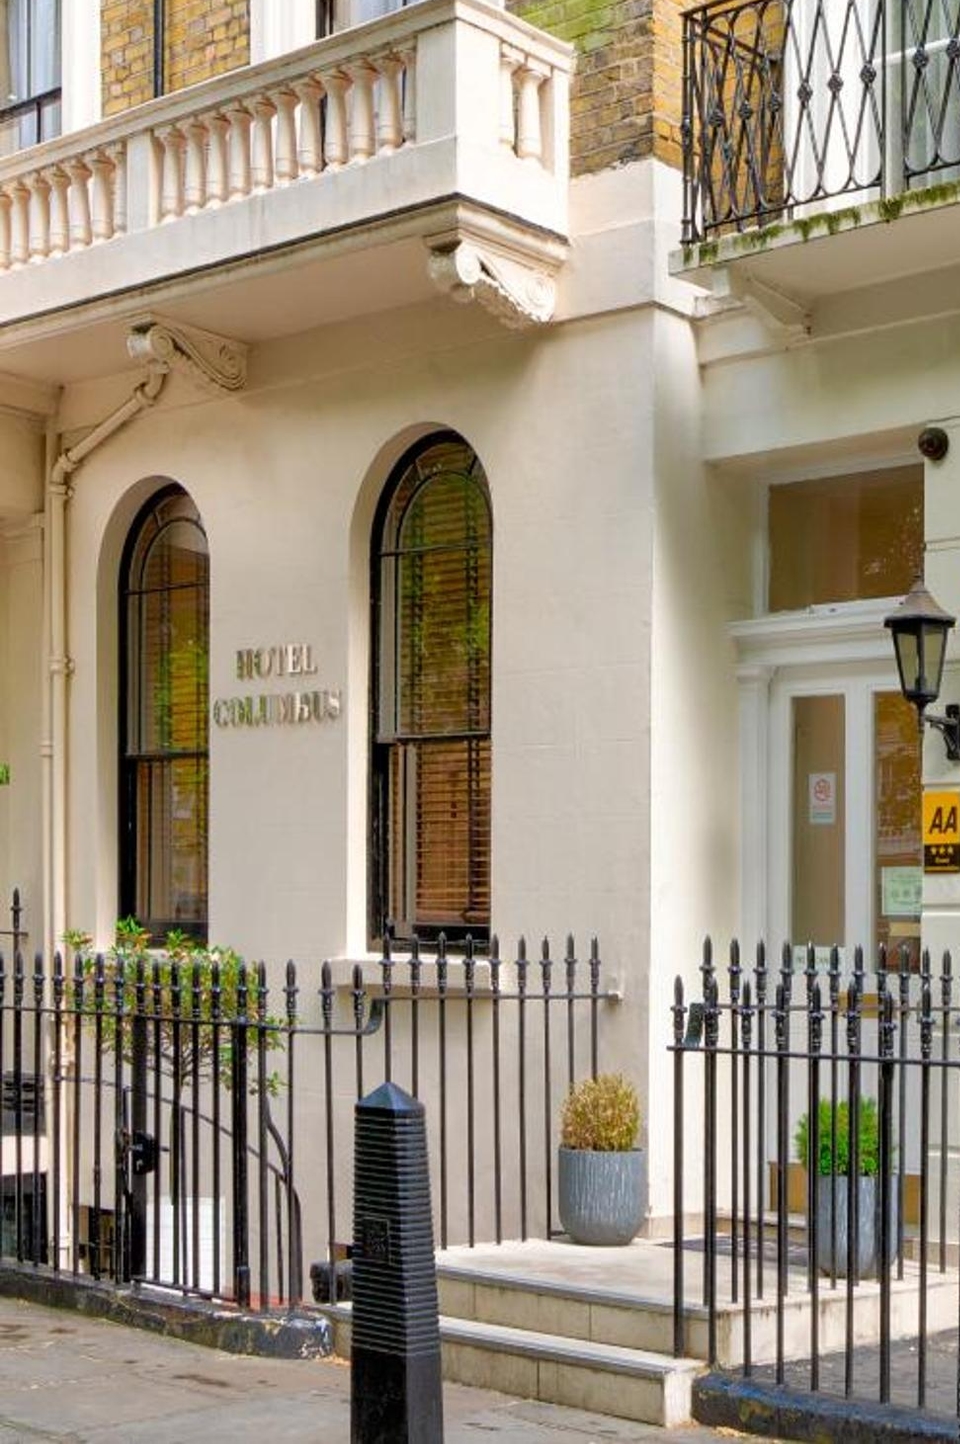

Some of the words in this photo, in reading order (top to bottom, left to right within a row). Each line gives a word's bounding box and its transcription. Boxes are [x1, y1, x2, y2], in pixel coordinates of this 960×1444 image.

[236, 644, 318, 680] HOTEL
[213, 689, 342, 728] COLUMBUS
[929, 805, 958, 834] AA
